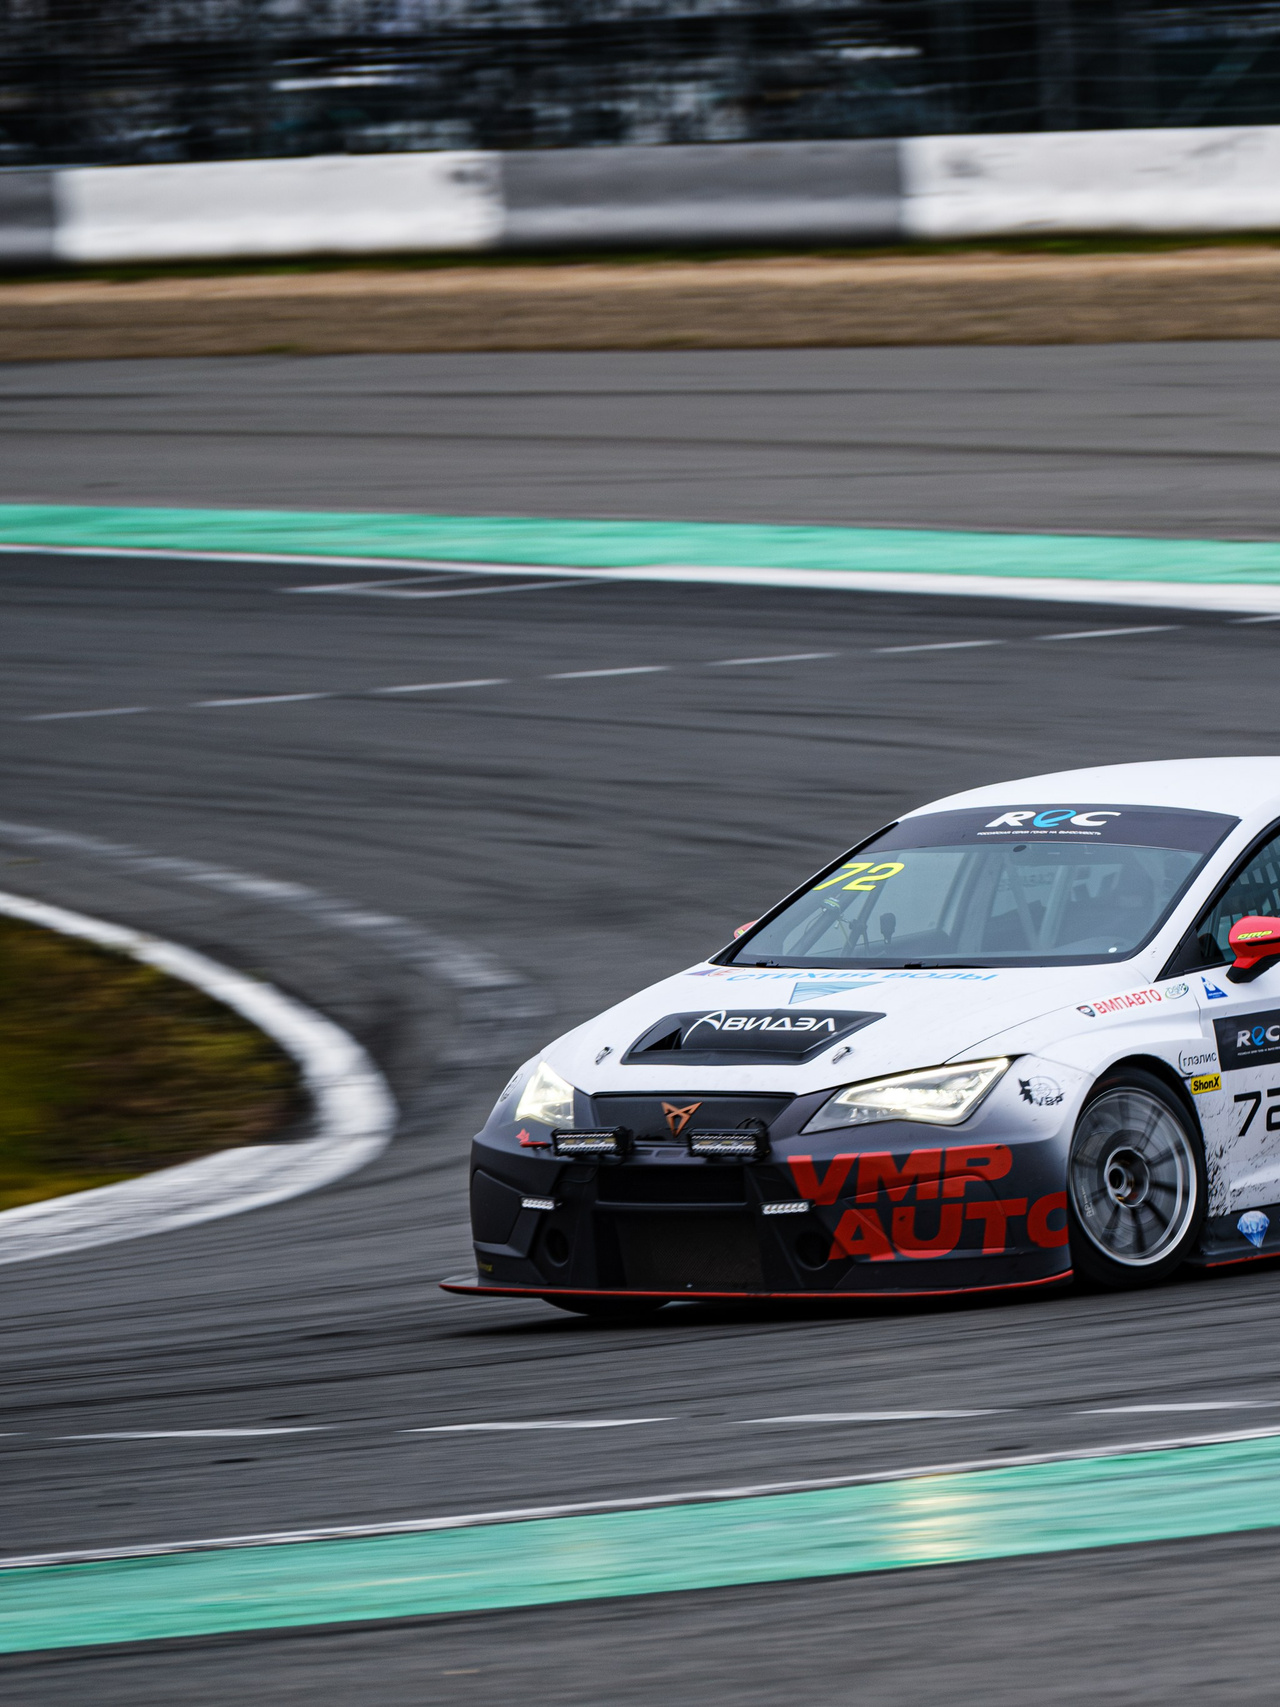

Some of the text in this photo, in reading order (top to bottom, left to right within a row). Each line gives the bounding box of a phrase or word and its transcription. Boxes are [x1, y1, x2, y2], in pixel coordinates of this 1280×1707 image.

[812, 862, 905, 891] 72
[881, 972, 999, 981] ВОДЫ
[1093, 989, 1163, 1014] ВМПАВТО
[1193, 1076, 1220, 1092] ShonX
[787, 1143, 1013, 1206] VMP
[828, 1190, 1070, 1262] AUTO
